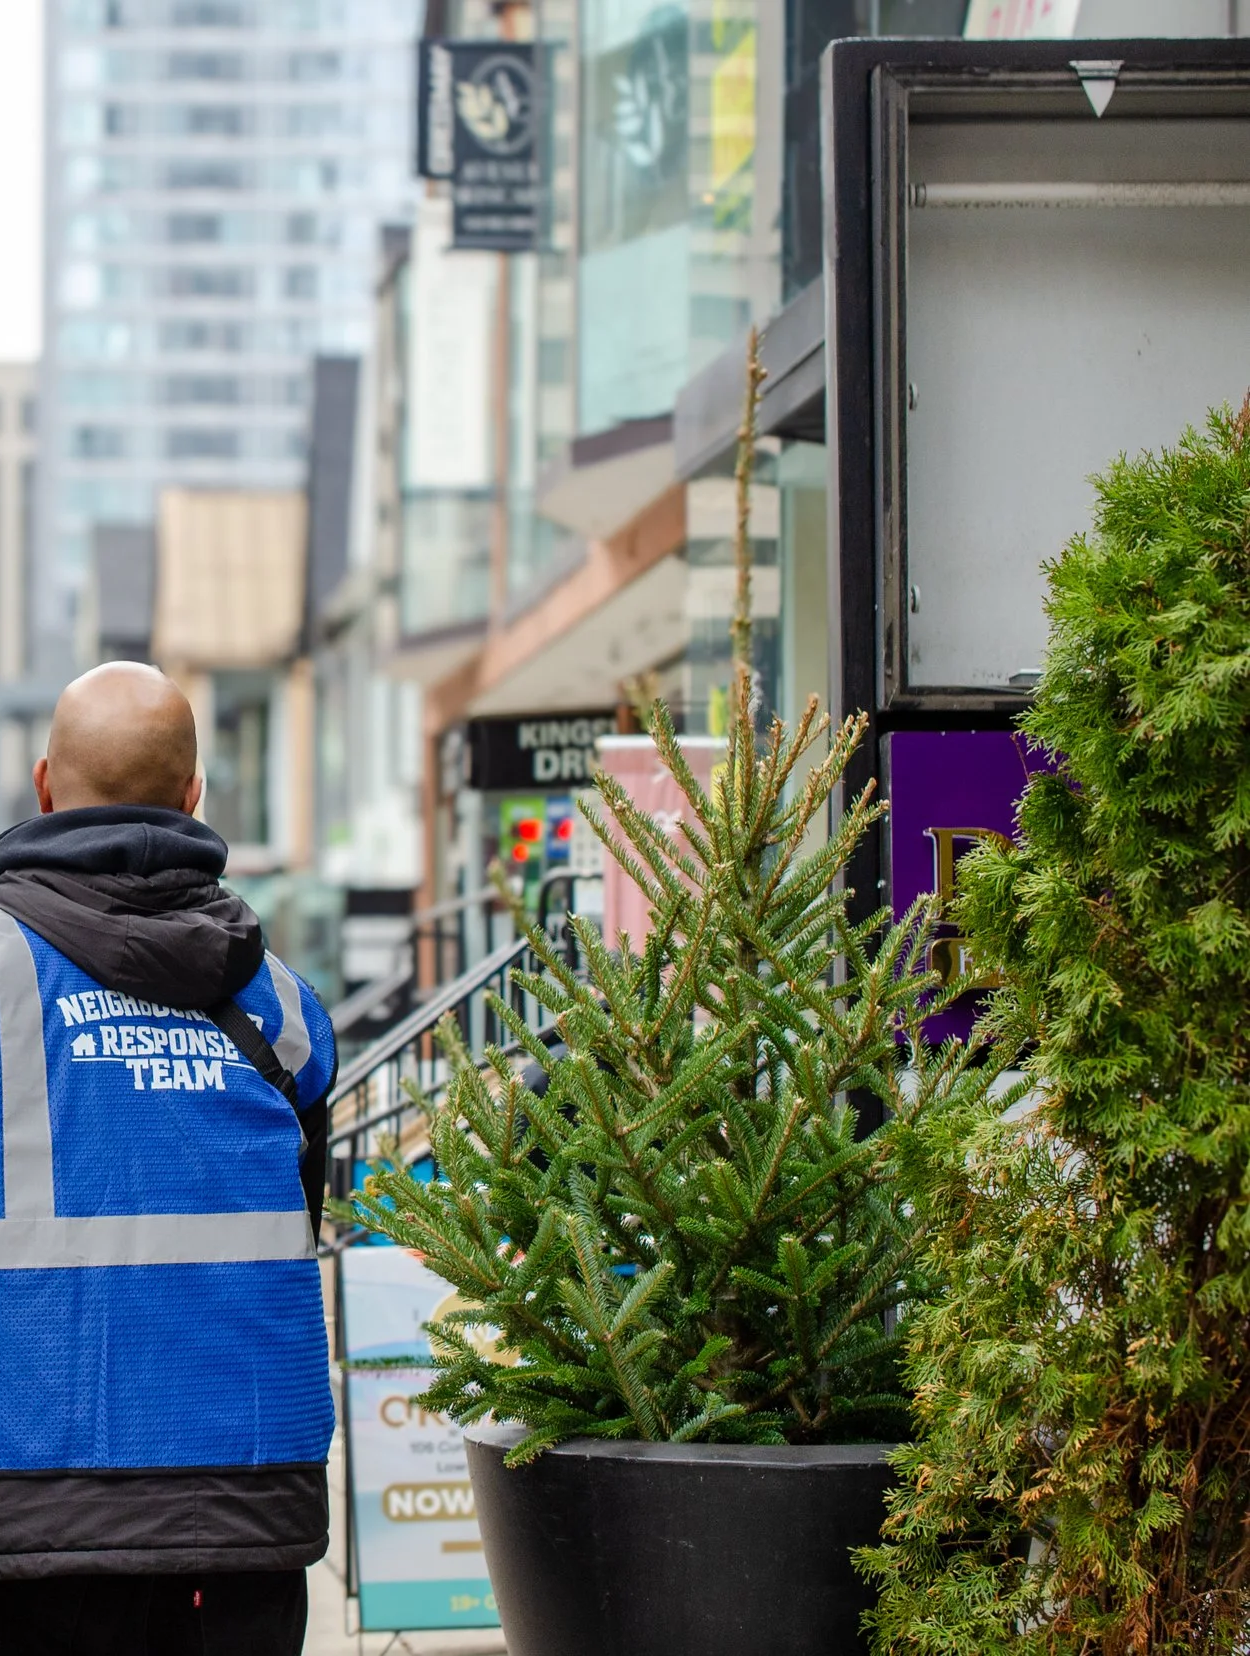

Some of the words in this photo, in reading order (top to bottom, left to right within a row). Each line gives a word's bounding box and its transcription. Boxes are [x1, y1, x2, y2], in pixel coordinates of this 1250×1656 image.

[99, 1025, 240, 1061] RESPONSE
[125, 1058, 226, 1091] TEAM
[388, 1488, 475, 1518] NOW
